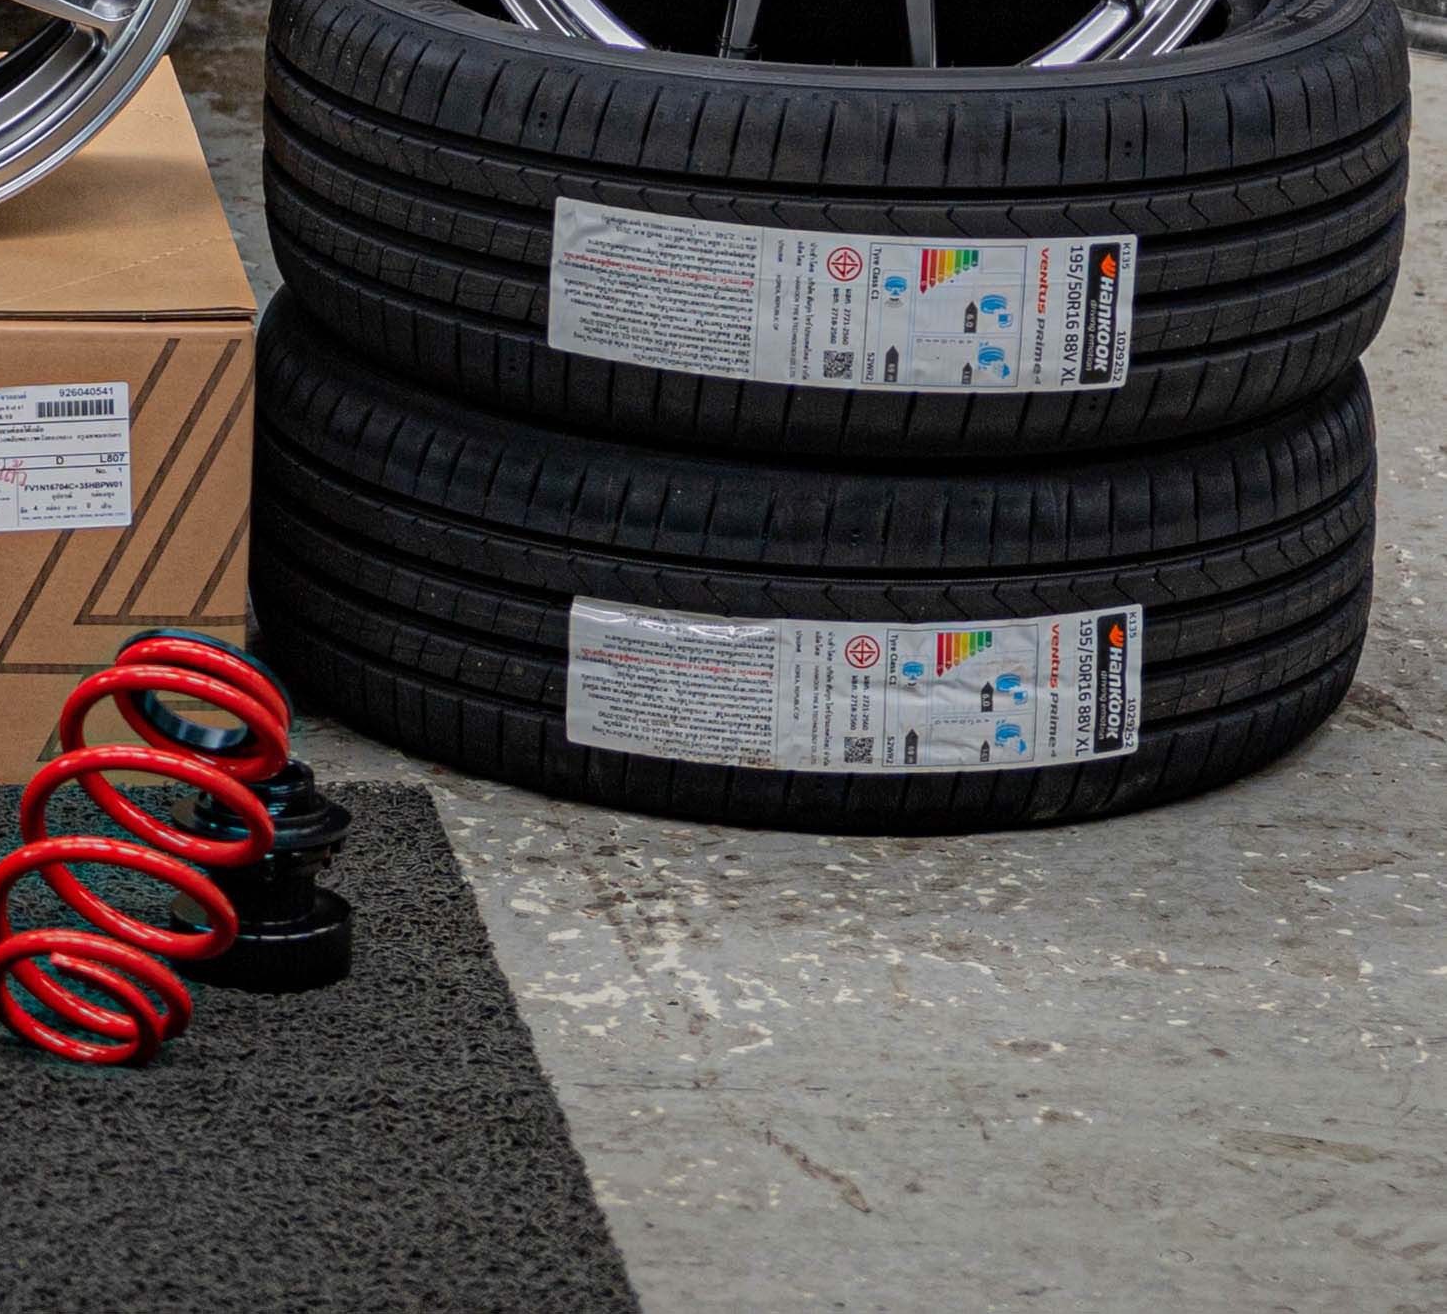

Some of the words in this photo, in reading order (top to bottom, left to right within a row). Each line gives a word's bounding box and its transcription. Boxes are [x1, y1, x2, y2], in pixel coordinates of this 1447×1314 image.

[872, 248, 882, 265] Tyre
[1122, 243, 1131, 269] K135
[872, 267, 880, 287] Class
[1066, 246, 1083, 329] 195/50R16
[1064, 334, 1078, 362] 88V
[1086, 334, 1094, 370] emotion
[1113, 331, 1126, 382] 1029252
[1061, 368, 1075, 385] XL
[59, 387, 114, 397] 926040541
[100, 453, 124, 463] L807
[1129, 612, 1137, 638] K135
[889, 635, 898, 651] Tyre
[889, 653, 897, 673] Class
[1078, 620, 1092, 701] 195/50R16
[1078, 706, 1091, 732] 88V
[1126, 698, 1136, 747] 1029252
[1076, 738, 1089, 756] XL
